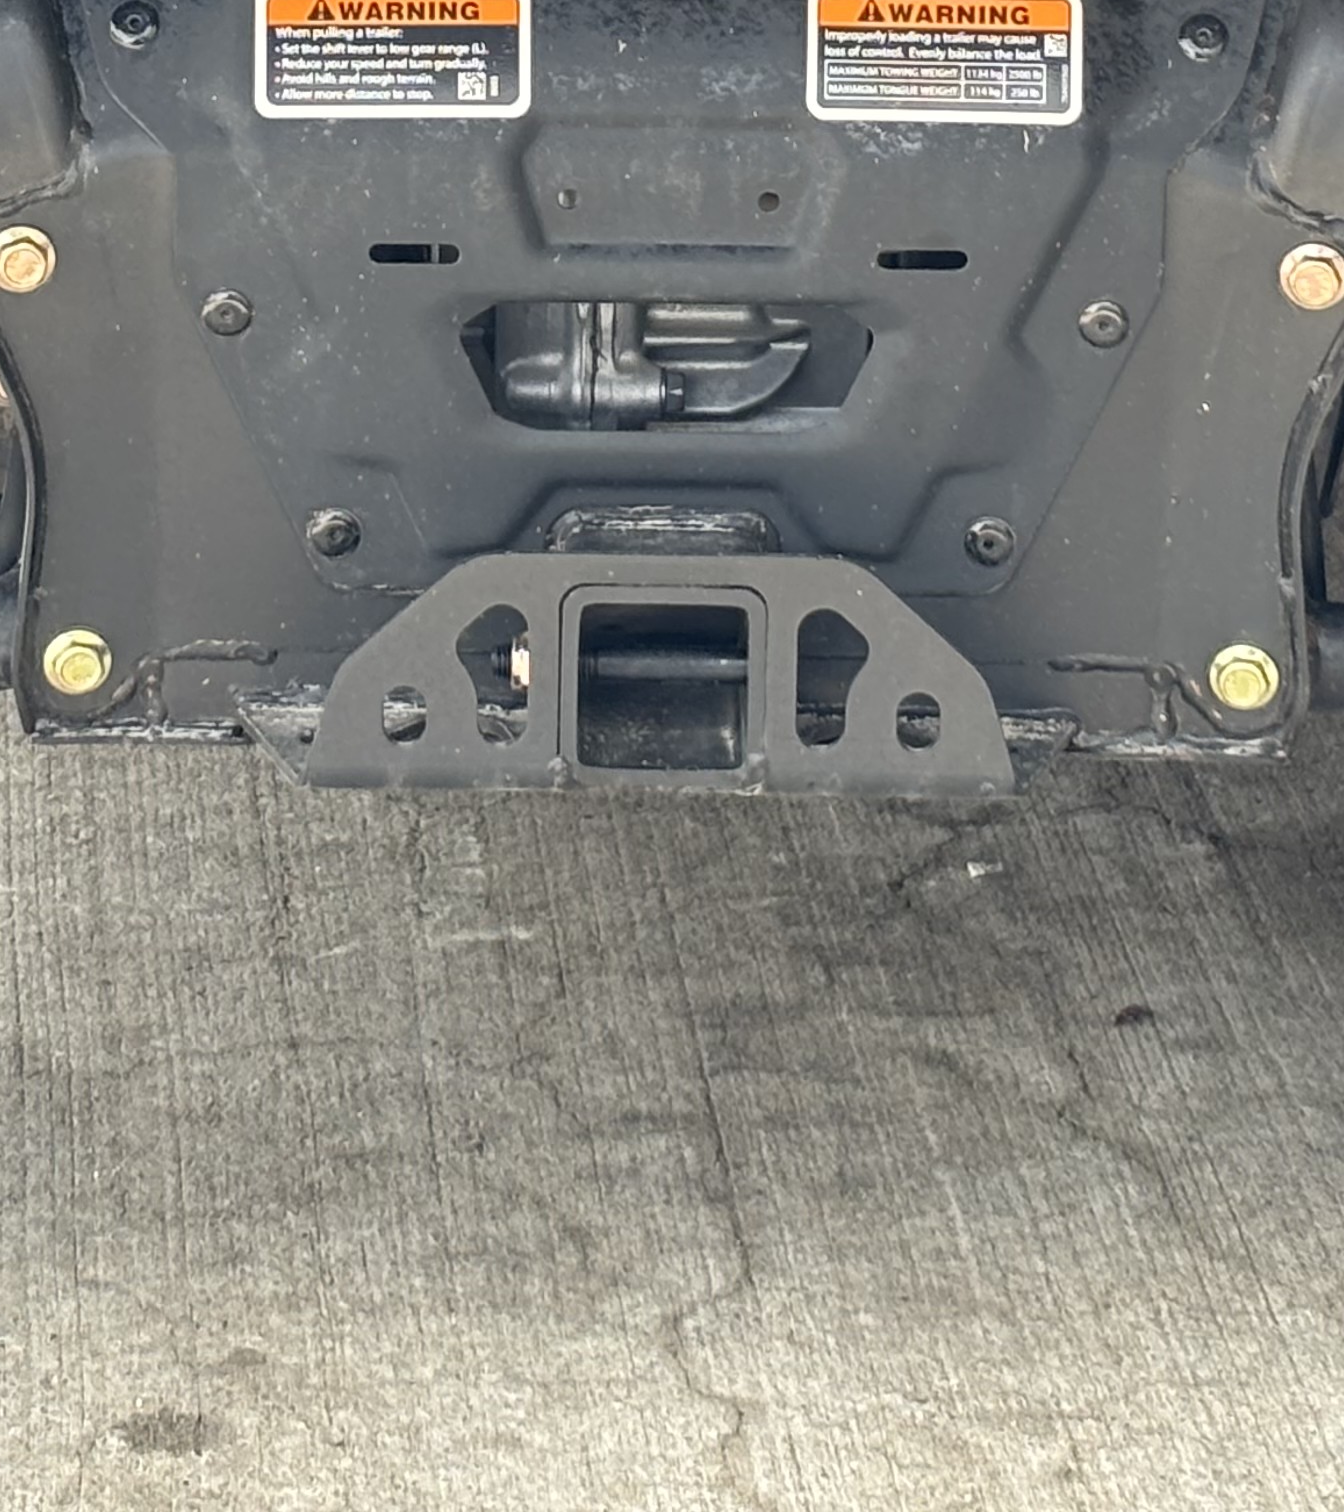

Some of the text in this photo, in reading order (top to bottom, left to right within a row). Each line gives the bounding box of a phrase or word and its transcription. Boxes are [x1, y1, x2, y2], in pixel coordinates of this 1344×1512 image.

[339, 1, 480, 21] WARNING
[889, 3, 1030, 25] WARNING
[276, 26, 311, 39] When
[312, 26, 354, 41] pulling
[356, 29, 364, 39] a
[825, 28, 1037, 46] Improperly loading a trailer may cause
[281, 42, 299, 55] Set
[301, 43, 320, 55] the
[322, 42, 346, 55] shift
[348, 43, 374, 55] lever
[376, 43, 388, 55] to
[389, 42, 410, 55] low
[411, 44, 436, 57] gear
[438, 45, 470, 57] range
[824, 44, 846, 57] loss
[847, 45, 861, 57] of
[909, 46, 946, 61] Evenly
[948, 47, 992, 60] balance
[994, 49, 1014, 60] the
[281, 57, 322, 70] Reduce
[324, 60, 349, 72] your
[350, 57, 384, 72] speed
[385, 57, 407, 69] and
[409, 58, 433, 69] turn
[829, 65, 879, 76] MAXIMUM
[879, 67, 919, 78] TOWING
[920, 67, 959, 78] WEIGHT
[281, 72, 314, 85] Avoid
[339, 72, 360, 84] and
[361, 73, 395, 87] rough
[281, 88, 313, 100] Allow
[314, 90, 343, 100] more
[344, 88, 391, 100] distance
[392, 89, 405, 100] to
[828, 83, 878, 94] MAXIMUM
[878, 85, 919, 95] TONGUE
[920, 85, 959, 96] WEIGHT
[988, 86, 1002, 98] kg
